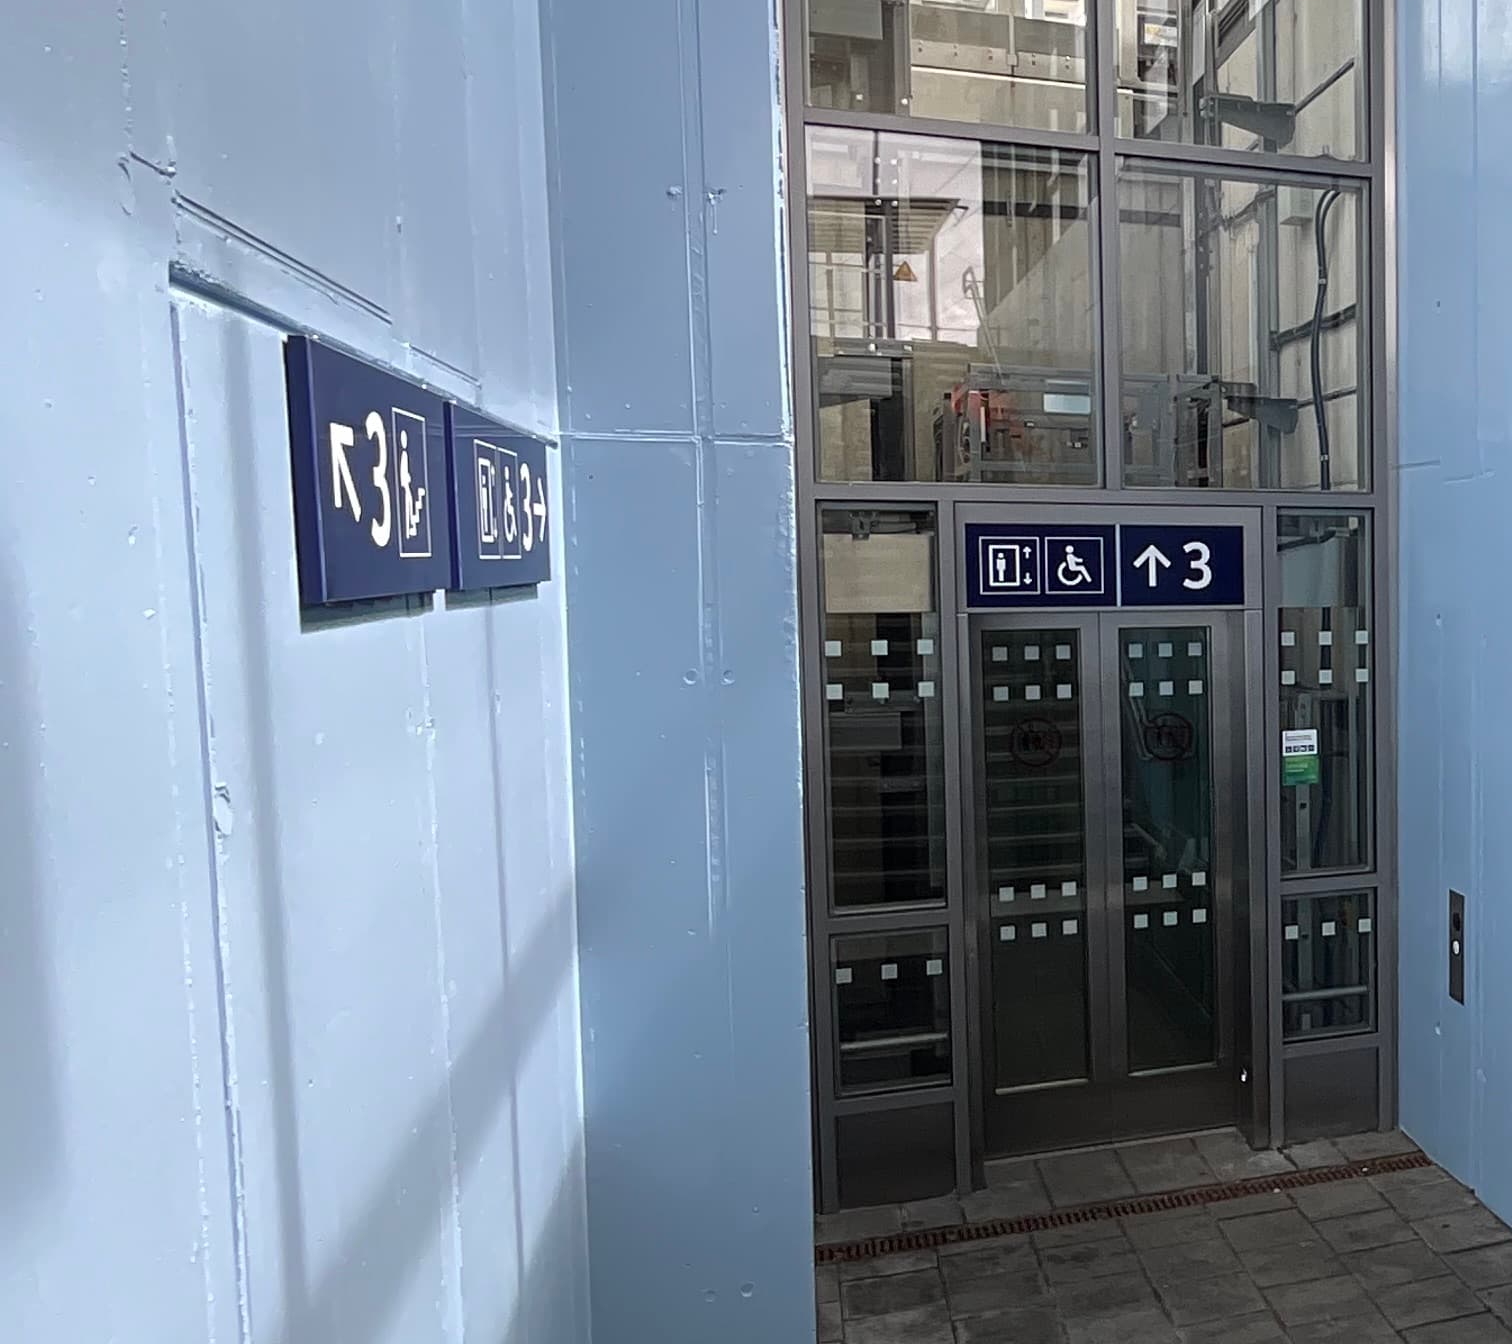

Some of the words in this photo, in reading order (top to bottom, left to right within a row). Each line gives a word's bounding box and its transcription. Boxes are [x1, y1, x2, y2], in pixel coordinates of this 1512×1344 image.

[365, 411, 391, 546] 3
[520, 463, 533, 552] 3
[1183, 542, 1212, 589] 3
